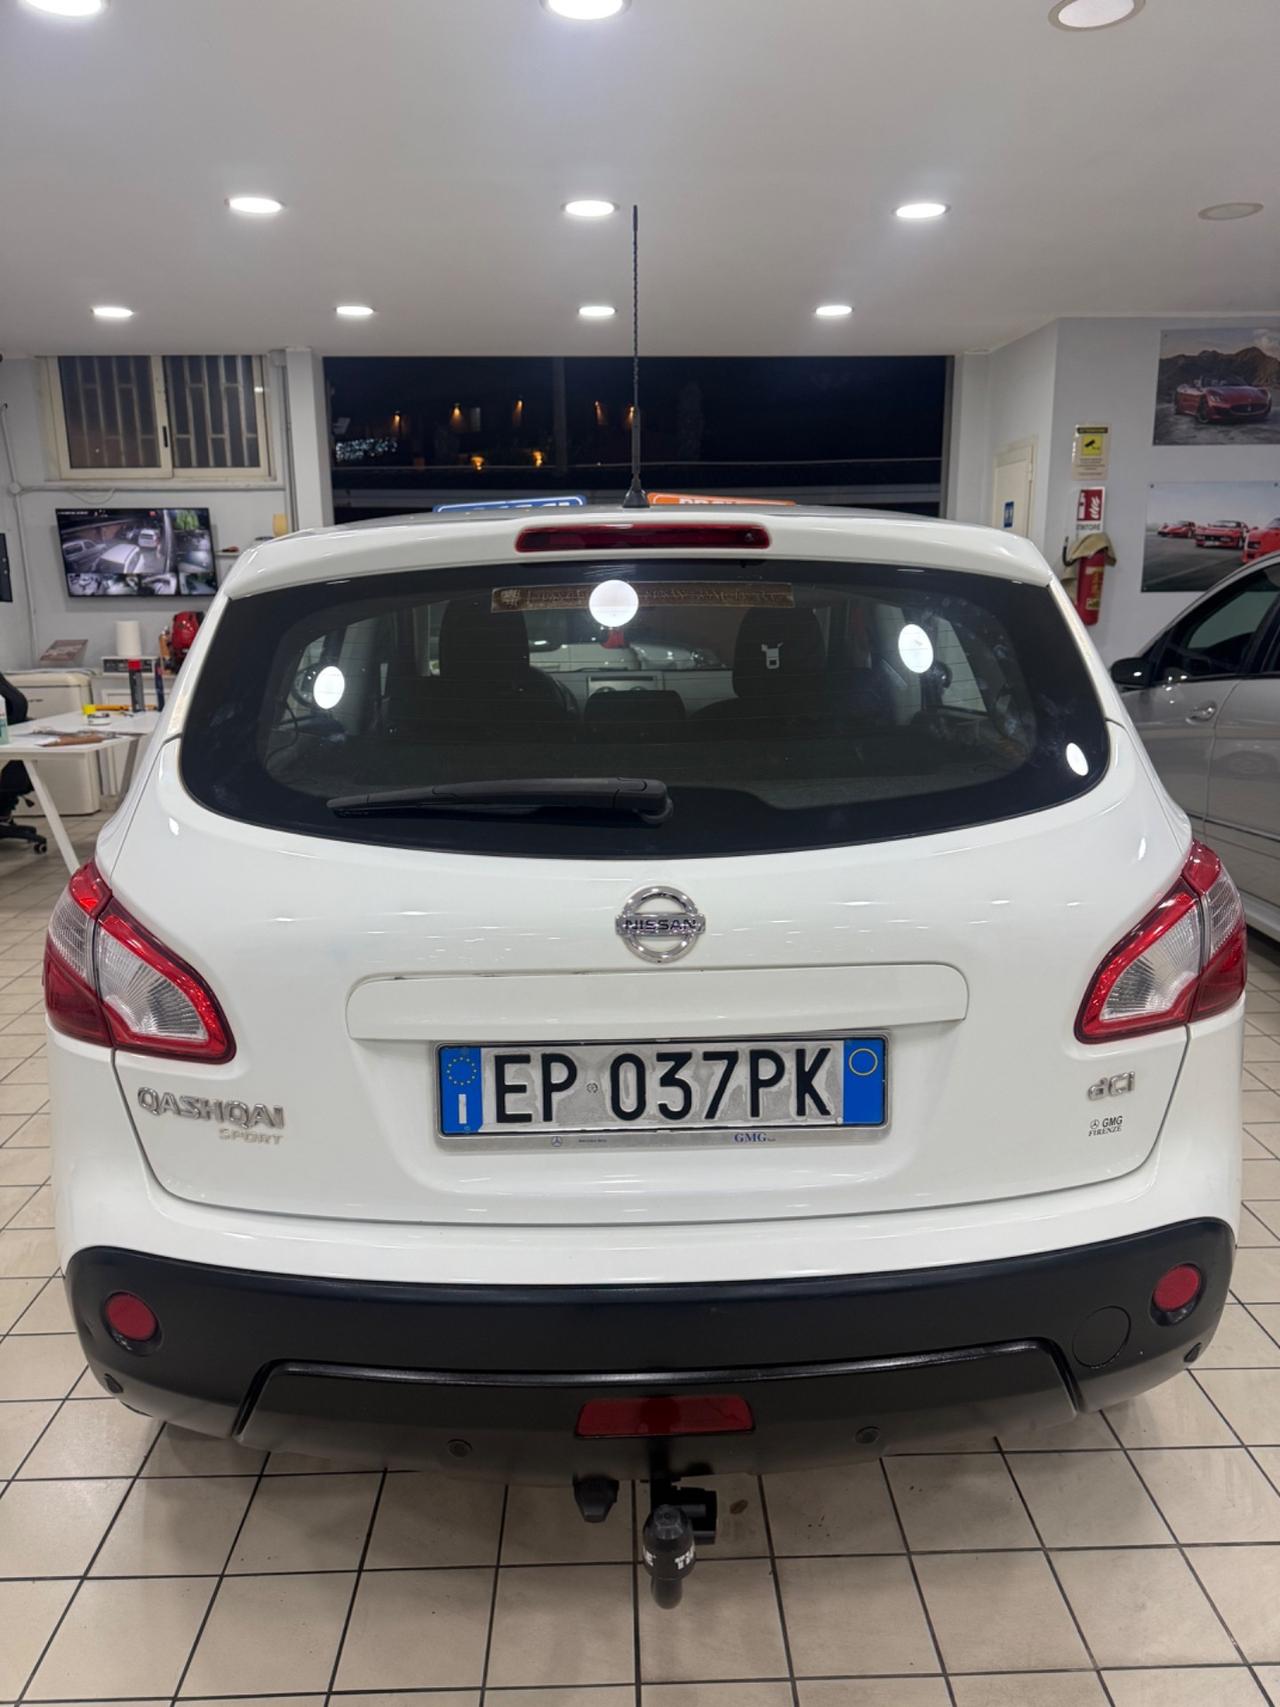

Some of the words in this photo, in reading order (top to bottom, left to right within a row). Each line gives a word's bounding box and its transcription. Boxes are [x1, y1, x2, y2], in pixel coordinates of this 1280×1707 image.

[624, 918, 697, 931] NISSAN
[494, 1052, 578, 1123] EP
[610, 1047, 831, 1121] 037PK
[137, 1086, 285, 1129] QASHQAI
[1102, 1115, 1123, 1128] GMG
[219, 1128, 284, 1145] SPORT
[734, 1132, 768, 1143] GMG
[1088, 1126, 1121, 1137] FIRENZE
